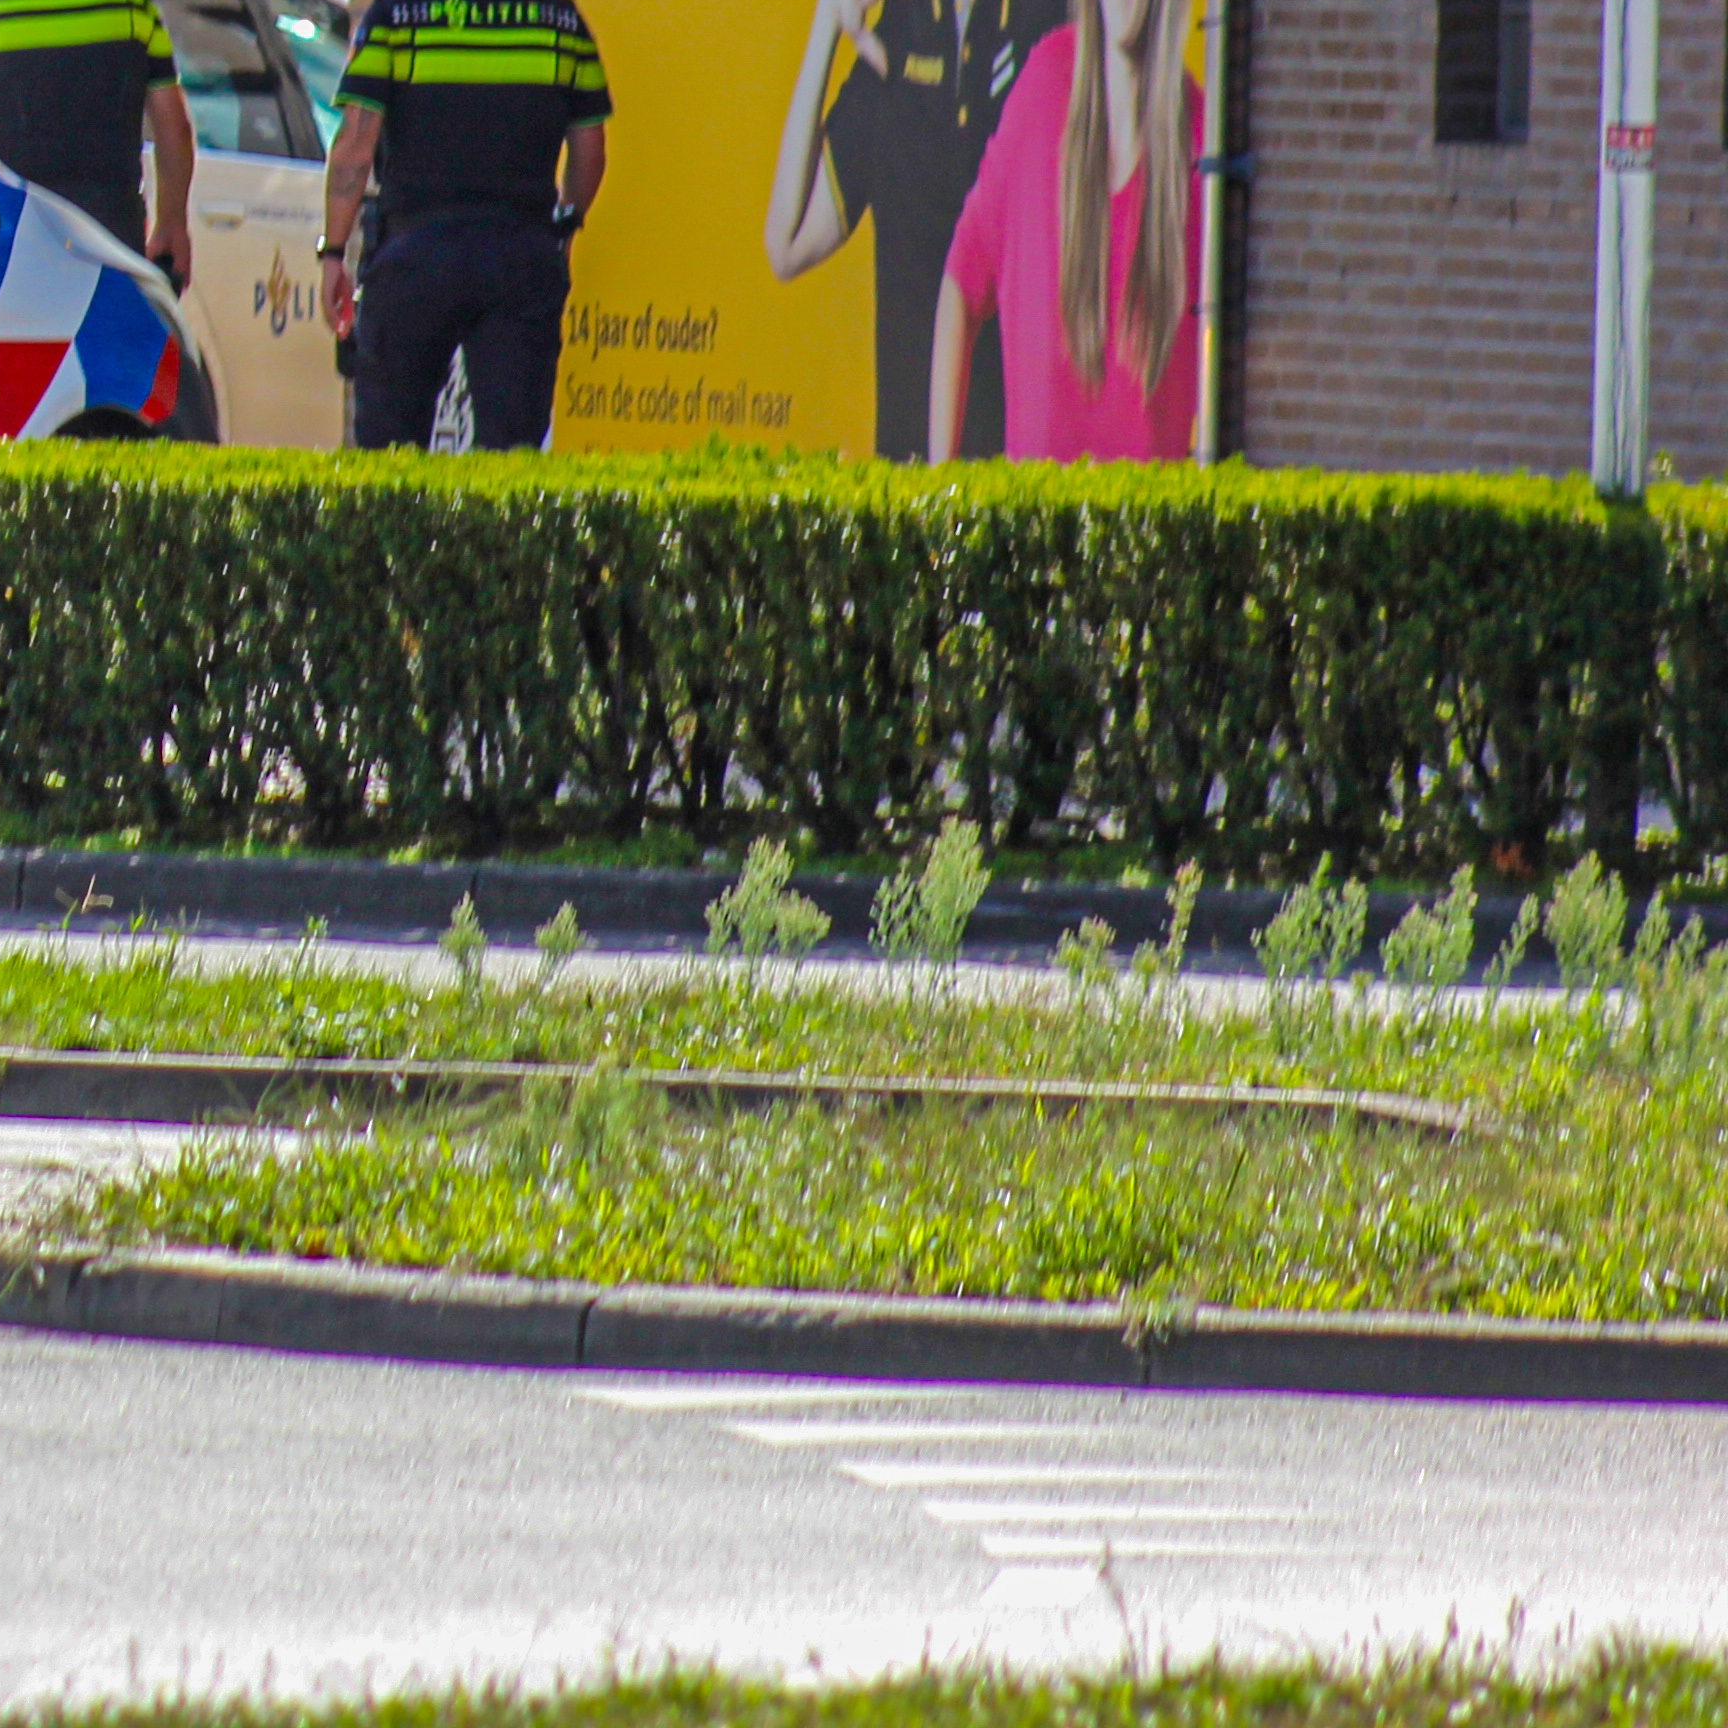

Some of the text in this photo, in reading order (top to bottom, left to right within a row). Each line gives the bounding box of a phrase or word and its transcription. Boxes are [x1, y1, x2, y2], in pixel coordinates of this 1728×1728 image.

[255, 279, 314, 339] POLI
[568, 299, 719, 364] 14 jaar of ouder?
[565, 372, 793, 429] Scan de code of mail naar
